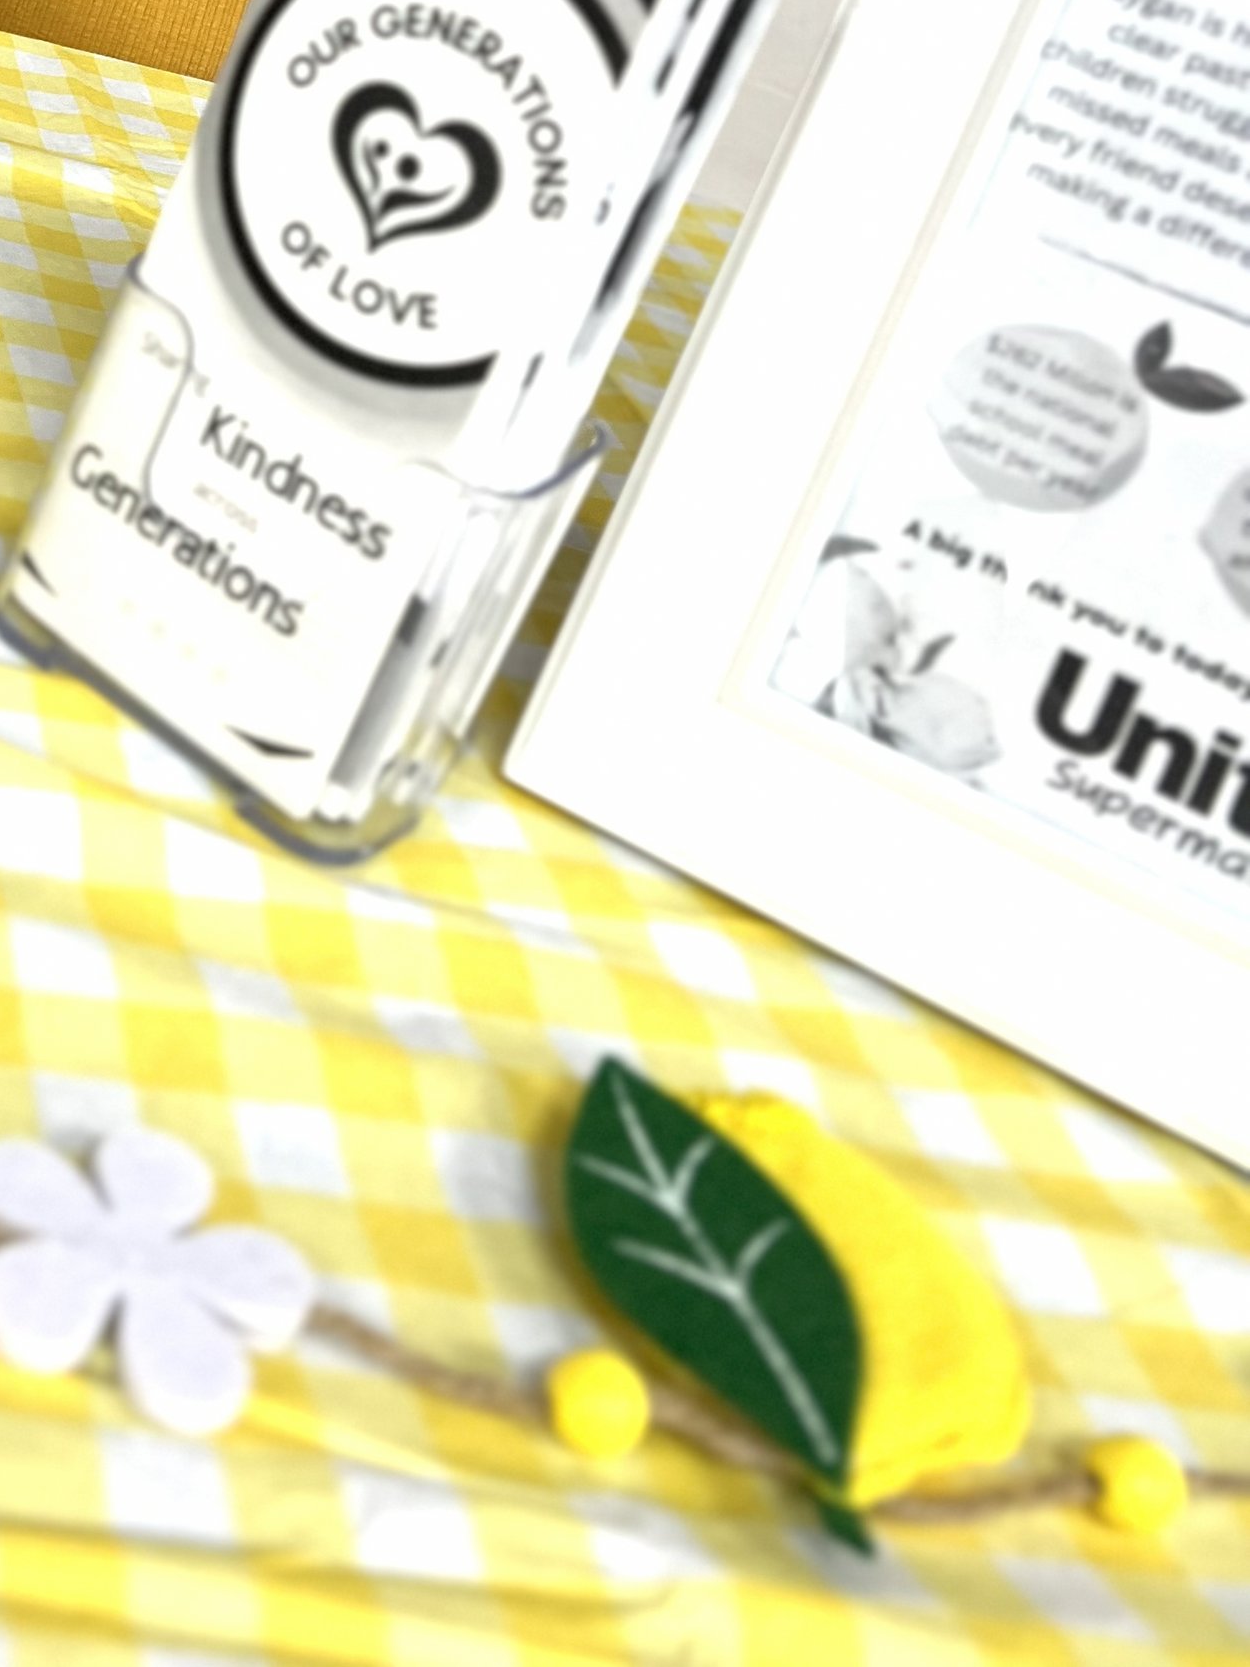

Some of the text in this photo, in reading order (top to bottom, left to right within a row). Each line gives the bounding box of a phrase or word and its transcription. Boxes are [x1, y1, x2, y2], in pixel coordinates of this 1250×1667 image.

[1107, 24, 1181, 61] clear
[1201, 10, 1225, 38] is
[287, 3, 569, 221] OUR GENERATIONS
[1048, 85, 1240, 175] missed meals
[1026, 163, 1130, 222] making
[1132, 206, 1153, 227] a
[1088, 138, 1182, 193] friend
[280, 220, 438, 330] OF LOVE
[981, 366, 1020, 396] the
[199, 403, 393, 561] Kindness
[69, 441, 305, 637] Generations
[903, 519, 921, 541] A
[928, 529, 974, 570] big
[980, 553, 1065, 609] thnk
[1069, 602, 1129, 637] you
[1134, 625, 1166, 655] to
